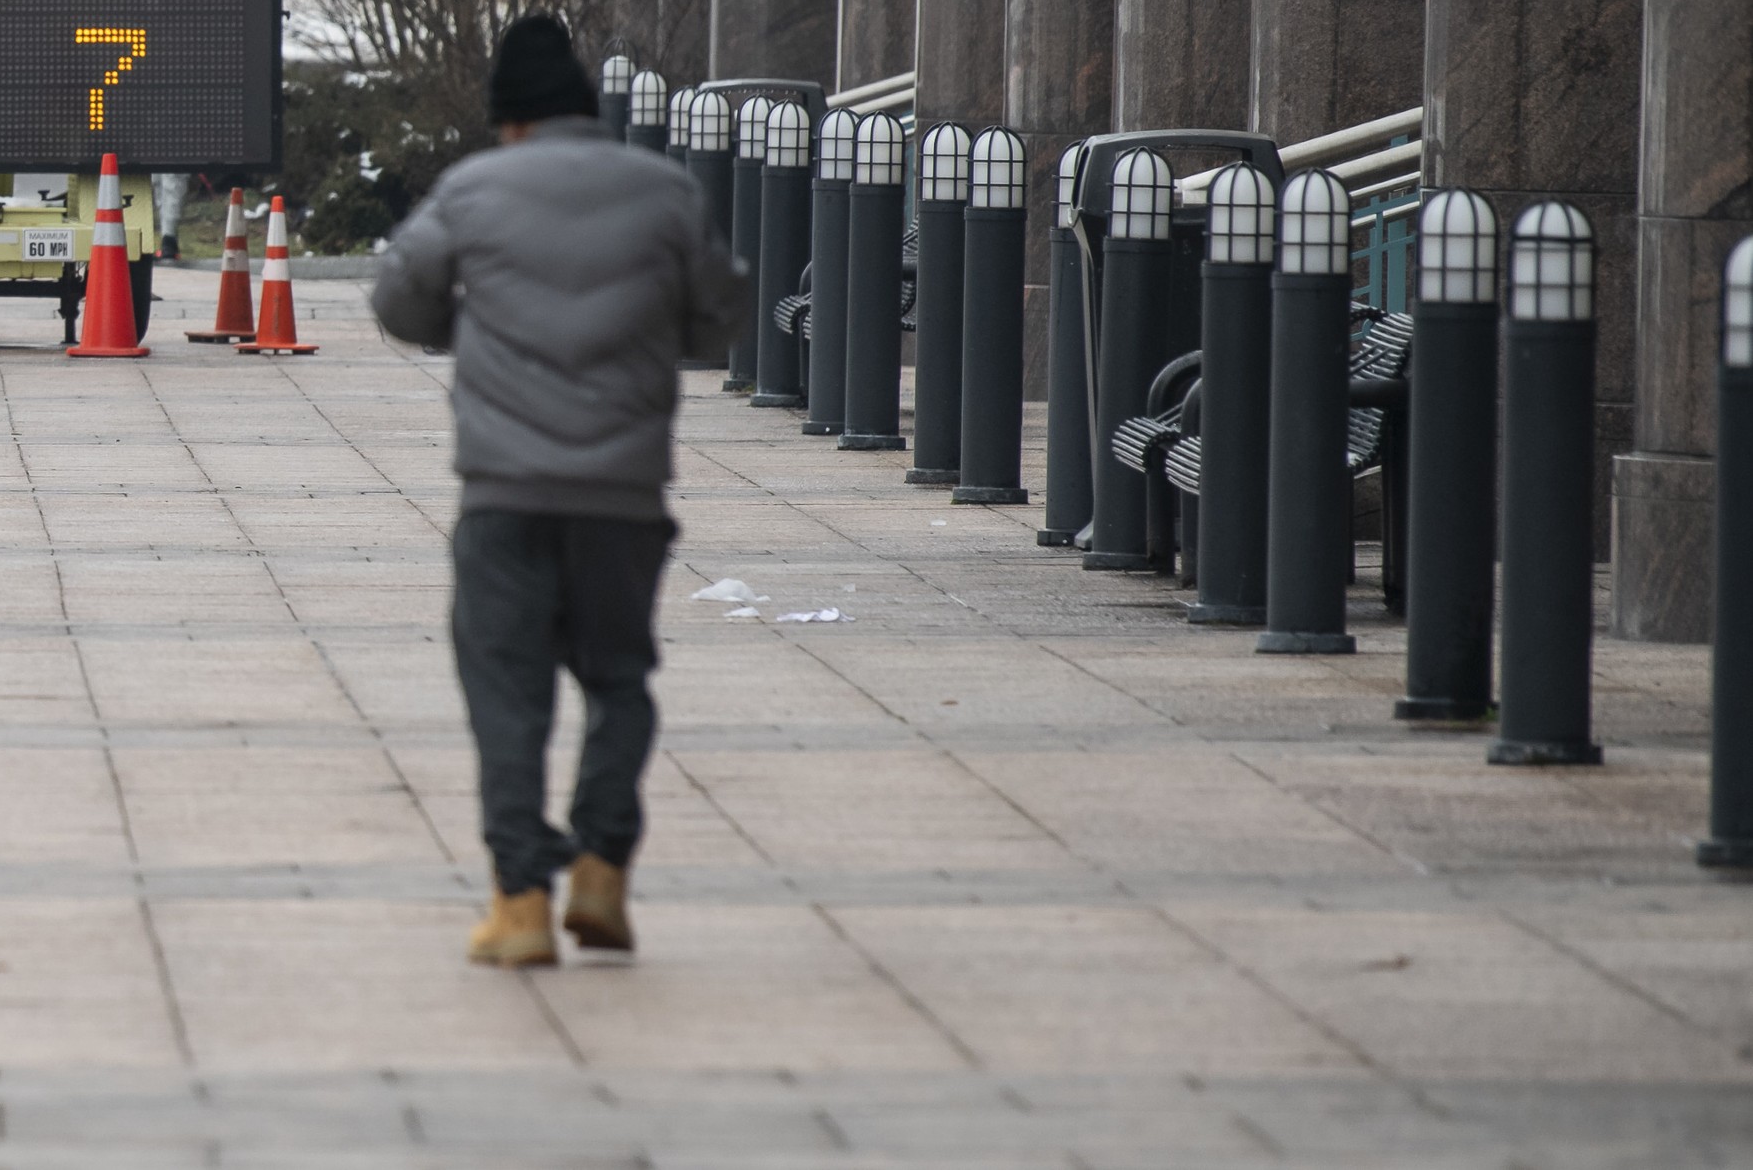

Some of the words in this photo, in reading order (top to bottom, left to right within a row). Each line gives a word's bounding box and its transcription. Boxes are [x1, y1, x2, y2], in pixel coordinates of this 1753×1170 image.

[75, 28, 147, 131] 7
[28, 232, 69, 240] MAXIMUM
[29, 242, 45, 257] 60
[49, 242, 68, 257] MPH
